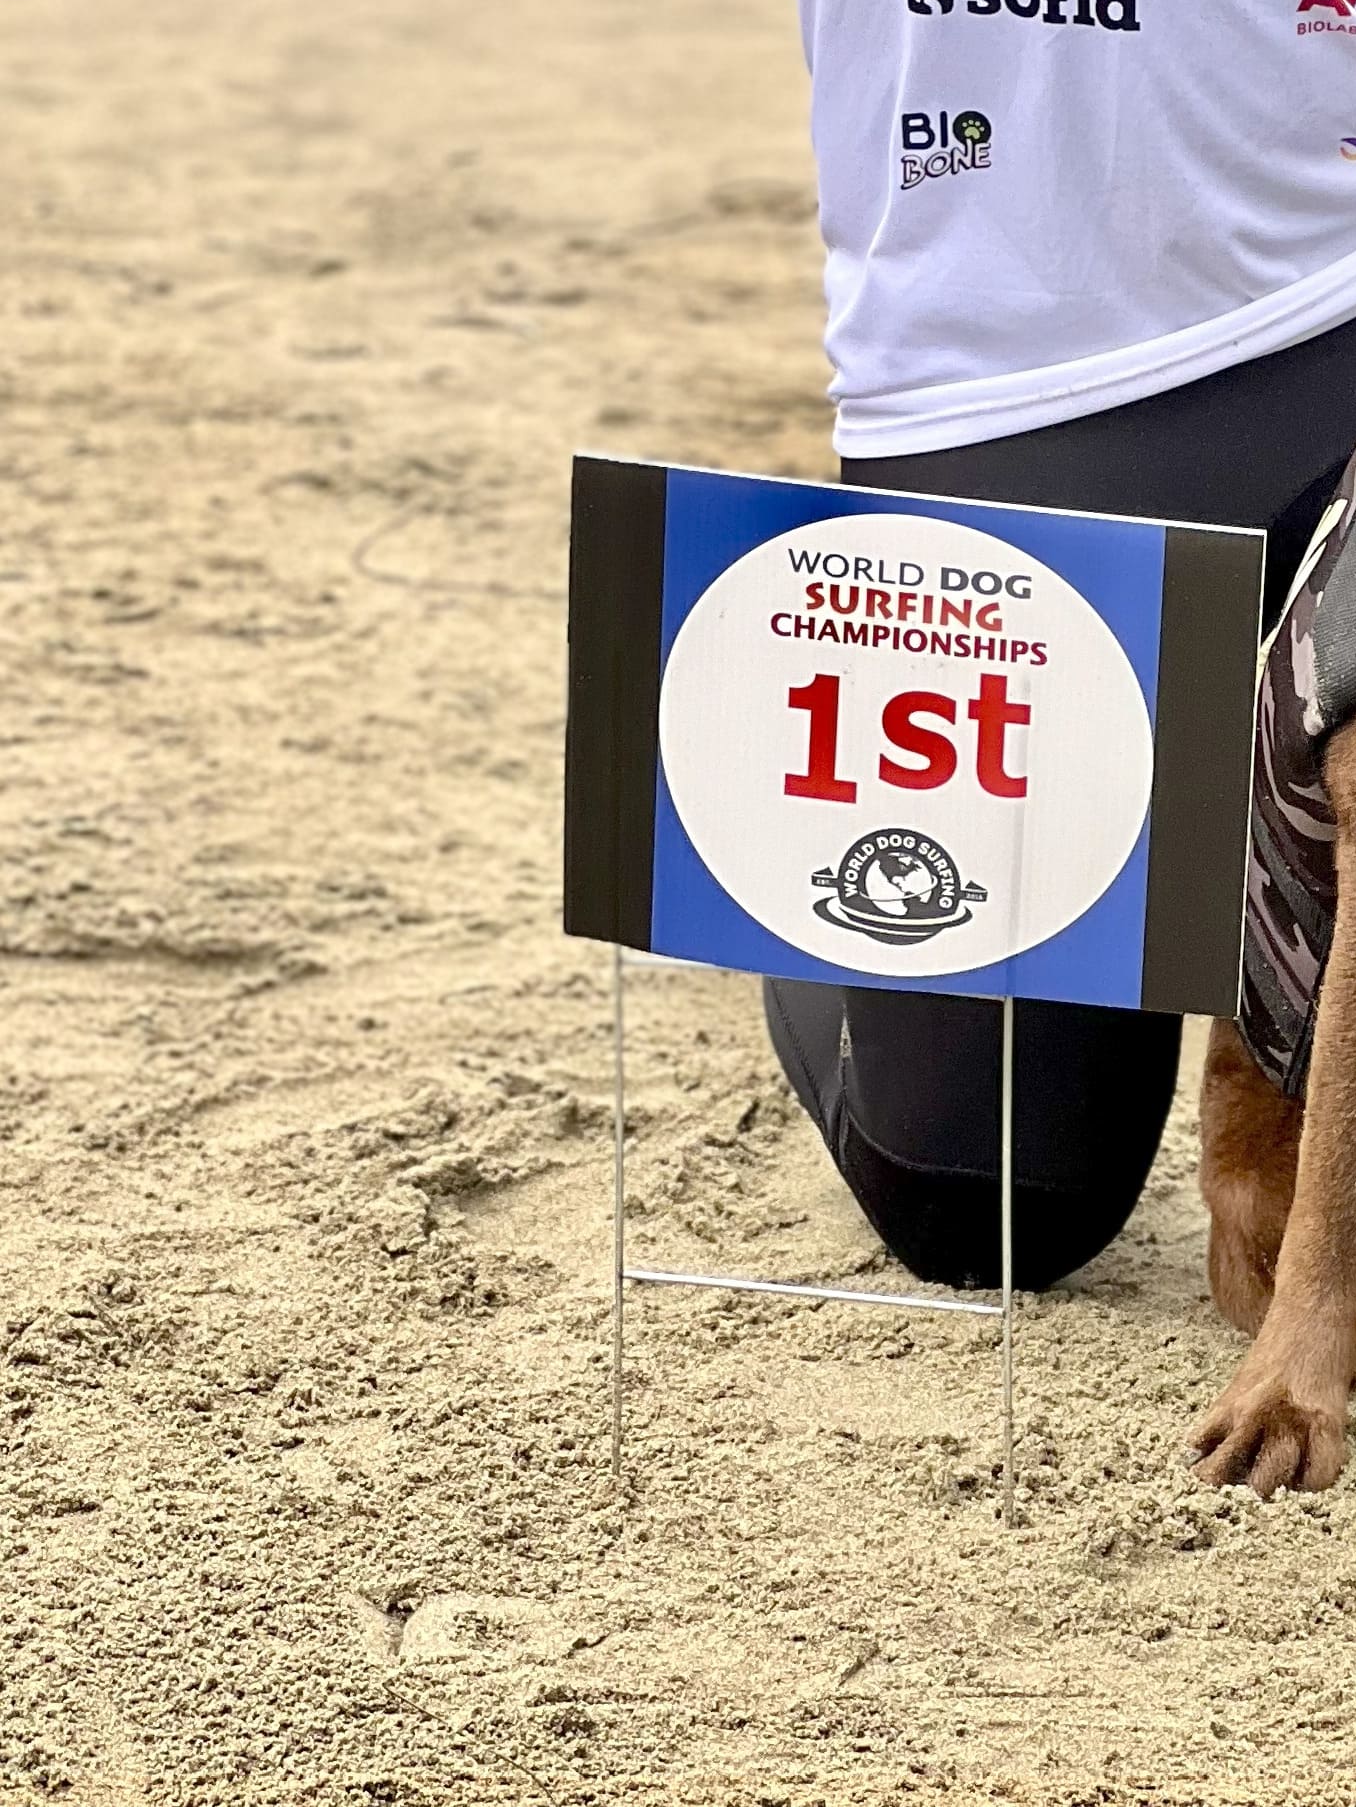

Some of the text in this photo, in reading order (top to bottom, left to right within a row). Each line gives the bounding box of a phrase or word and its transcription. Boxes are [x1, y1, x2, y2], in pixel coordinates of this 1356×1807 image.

[901, 110, 992, 150] BIO
[900, 138, 992, 190] BONE
[787, 548, 1032, 600] WORLD DOG
[805, 581, 1003, 632] SURFING
[770, 612, 1048, 666] CHAMPIONSHIPS
[783, 672, 1032, 804] 1st
[843, 833, 956, 909] WORLD DOG SURFING
